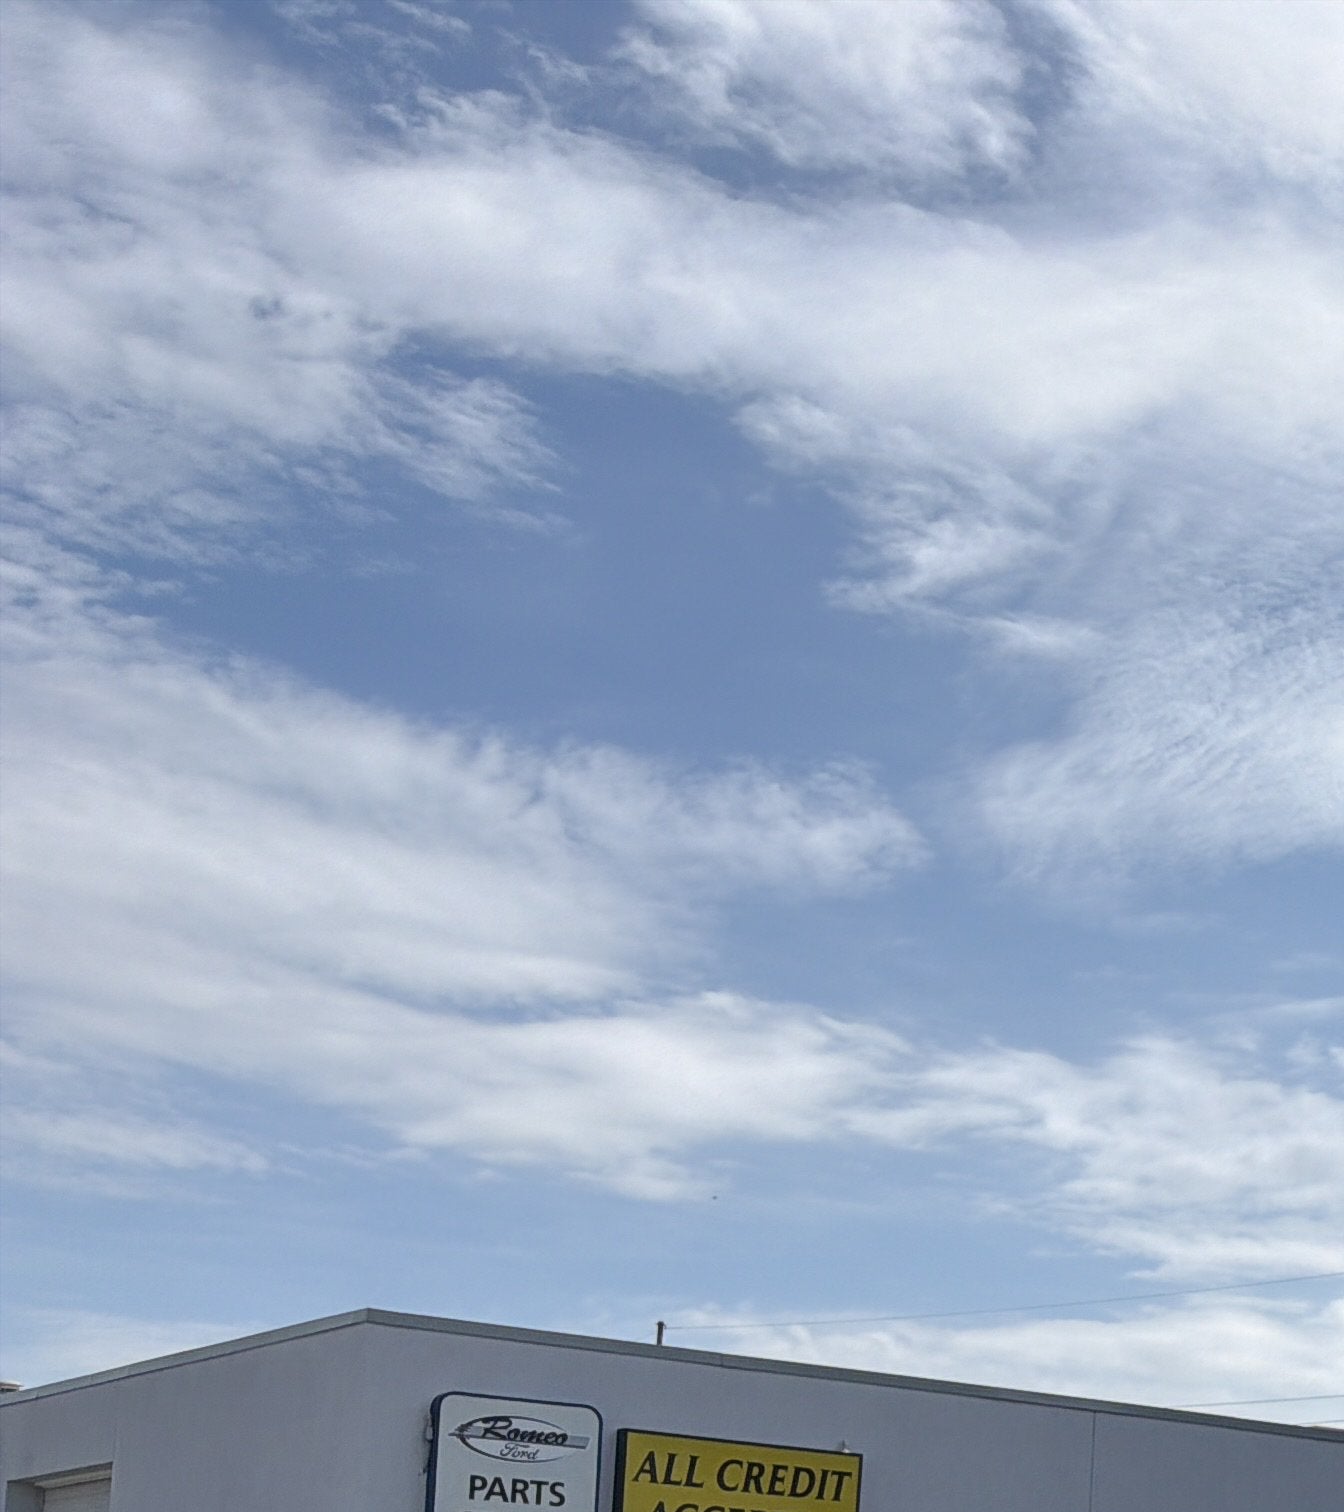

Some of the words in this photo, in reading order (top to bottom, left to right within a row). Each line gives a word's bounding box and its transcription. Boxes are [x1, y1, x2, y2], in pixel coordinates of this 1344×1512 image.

[480, 1416, 569, 1446] Romeo
[499, 1442, 540, 1460] Ford
[468, 1474, 566, 1507] PARTS
[631, 1450, 704, 1489] ALL
[716, 1458, 853, 1502] CREDIT
